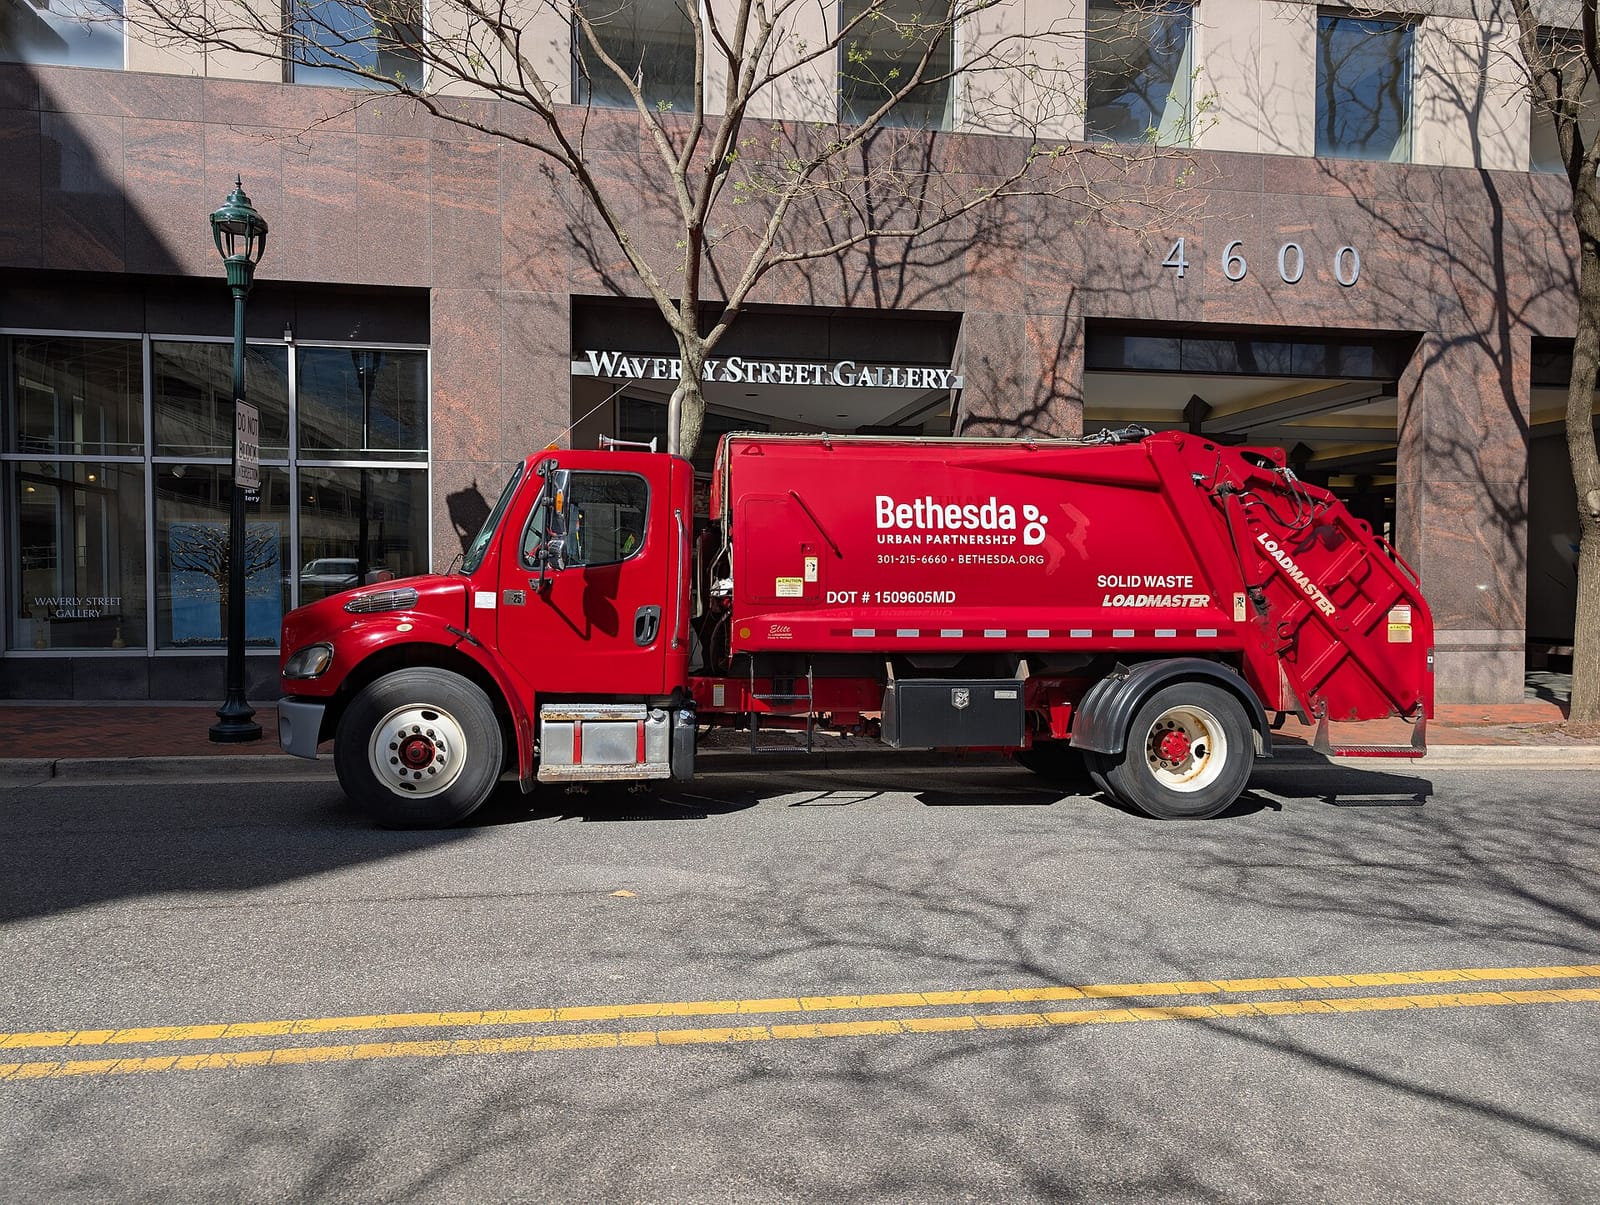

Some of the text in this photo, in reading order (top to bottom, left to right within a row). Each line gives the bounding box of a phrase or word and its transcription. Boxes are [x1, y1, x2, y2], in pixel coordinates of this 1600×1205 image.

[585, 350, 954, 389] WAVERY STREET GALLERY
[238, 412, 258, 437] DO NOT
[875, 495, 1017, 530] Bethesda
[877, 534, 1017, 546] URBAN PARTNERSHIP
[877, 554, 1045, 565] 301-215-6660 BETHESDA.ORG
[1257, 532, 1336, 617] LOADMASTER
[1097, 575, 1193, 588] SOLID WASTE
[35, 597, 121, 606] WAVERLY STREET
[826, 591, 956, 604] DOT # 1509605MD
[1102, 594, 1211, 608] LOADMASTER
[55, 609, 102, 618] GALLERY
[769, 624, 791, 633] Elite
